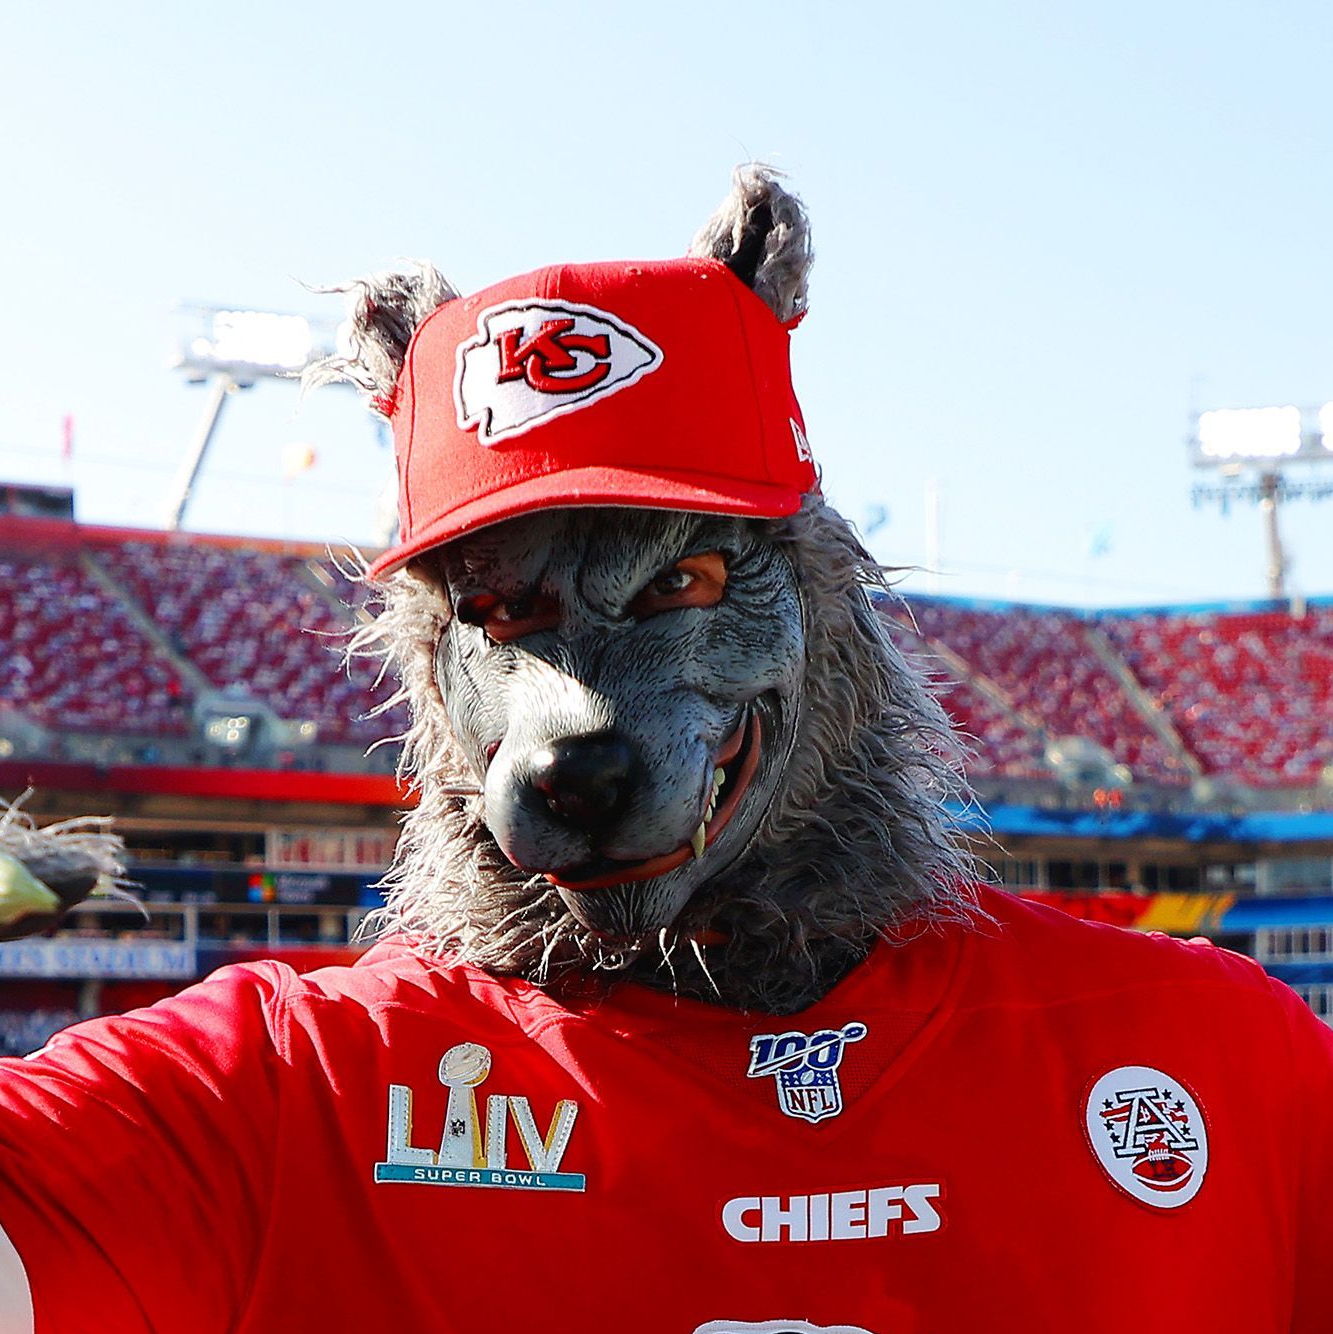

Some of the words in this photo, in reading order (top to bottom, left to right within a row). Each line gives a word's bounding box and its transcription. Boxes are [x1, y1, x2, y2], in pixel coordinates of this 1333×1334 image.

[494, 318, 612, 395] KC
[750, 1030, 847, 1072] 100
[788, 1088, 835, 1113] NFL
[1113, 1088, 1199, 1158] A
[414, 1168, 482, 1183] SUPER
[491, 1173, 547, 1187] BOWL
[722, 1183, 941, 1243] CHIEFS
